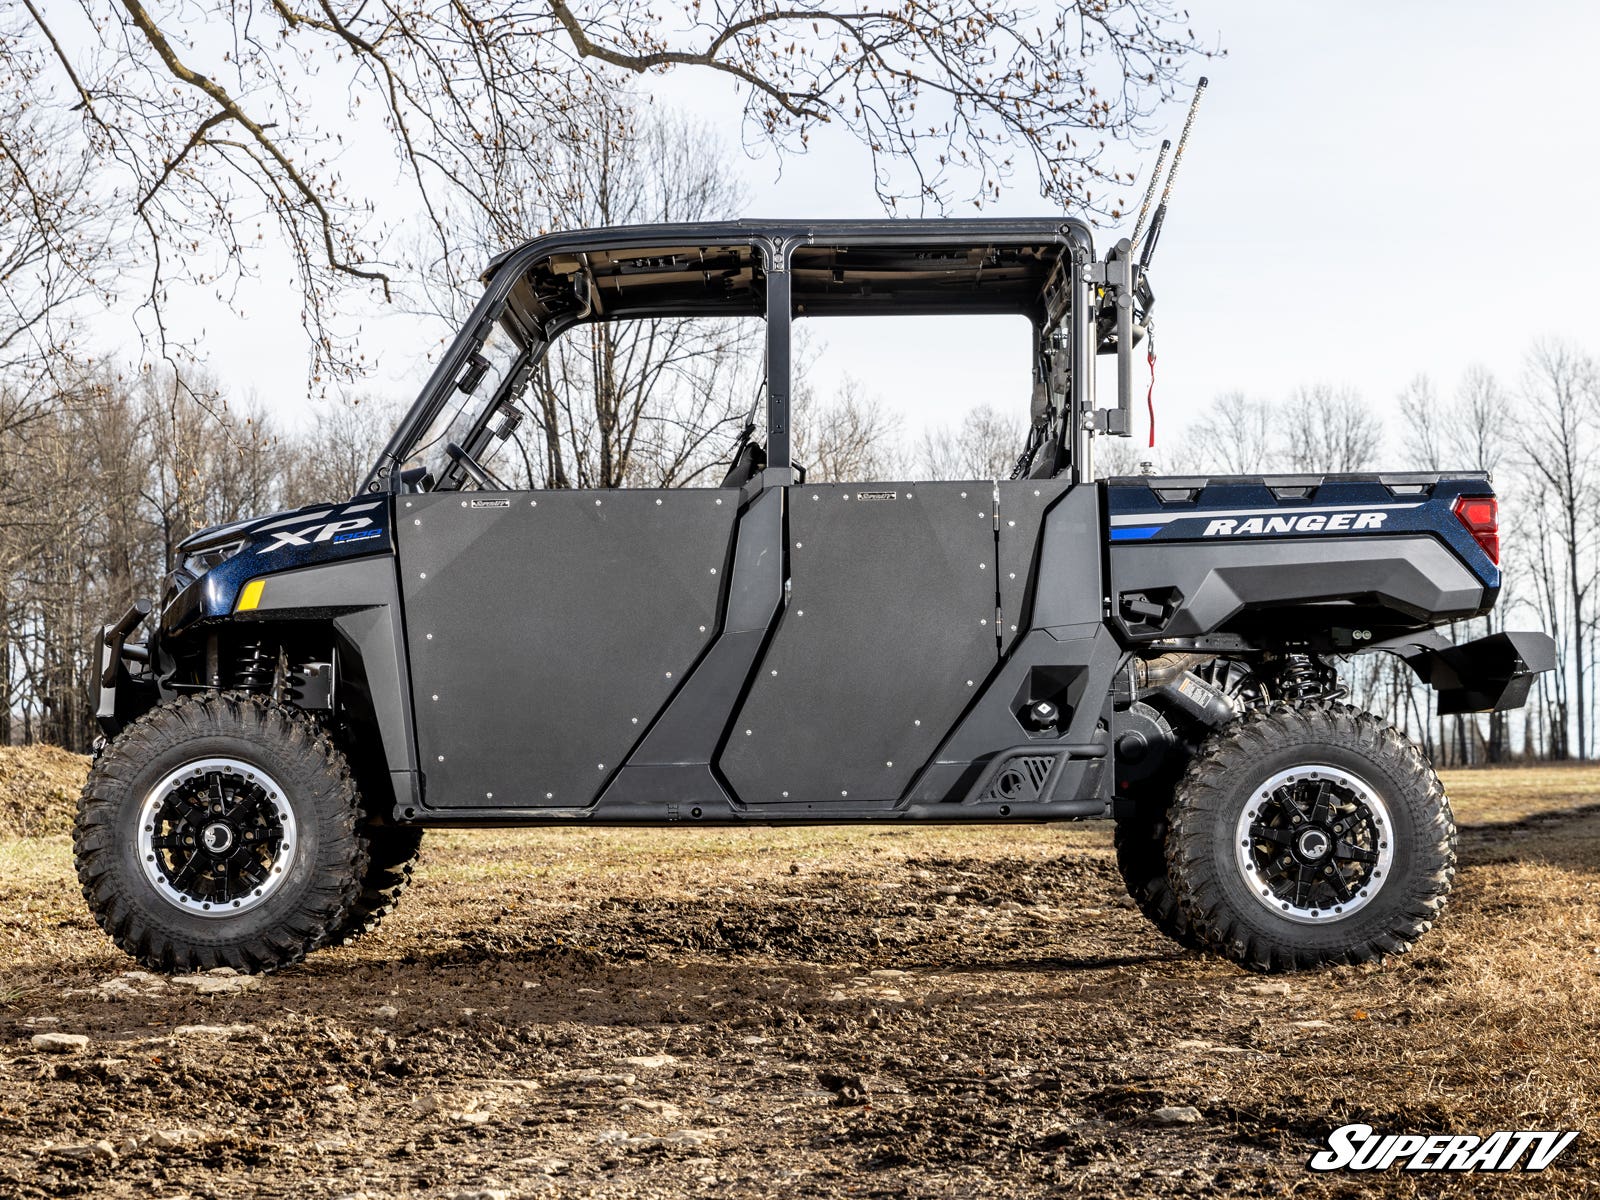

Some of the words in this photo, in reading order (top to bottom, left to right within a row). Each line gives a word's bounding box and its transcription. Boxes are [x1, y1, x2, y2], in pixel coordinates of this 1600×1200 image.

[256, 517, 373, 554] XP
[333, 528, 382, 542] 1000
[1202, 512, 1388, 536] RANGER
